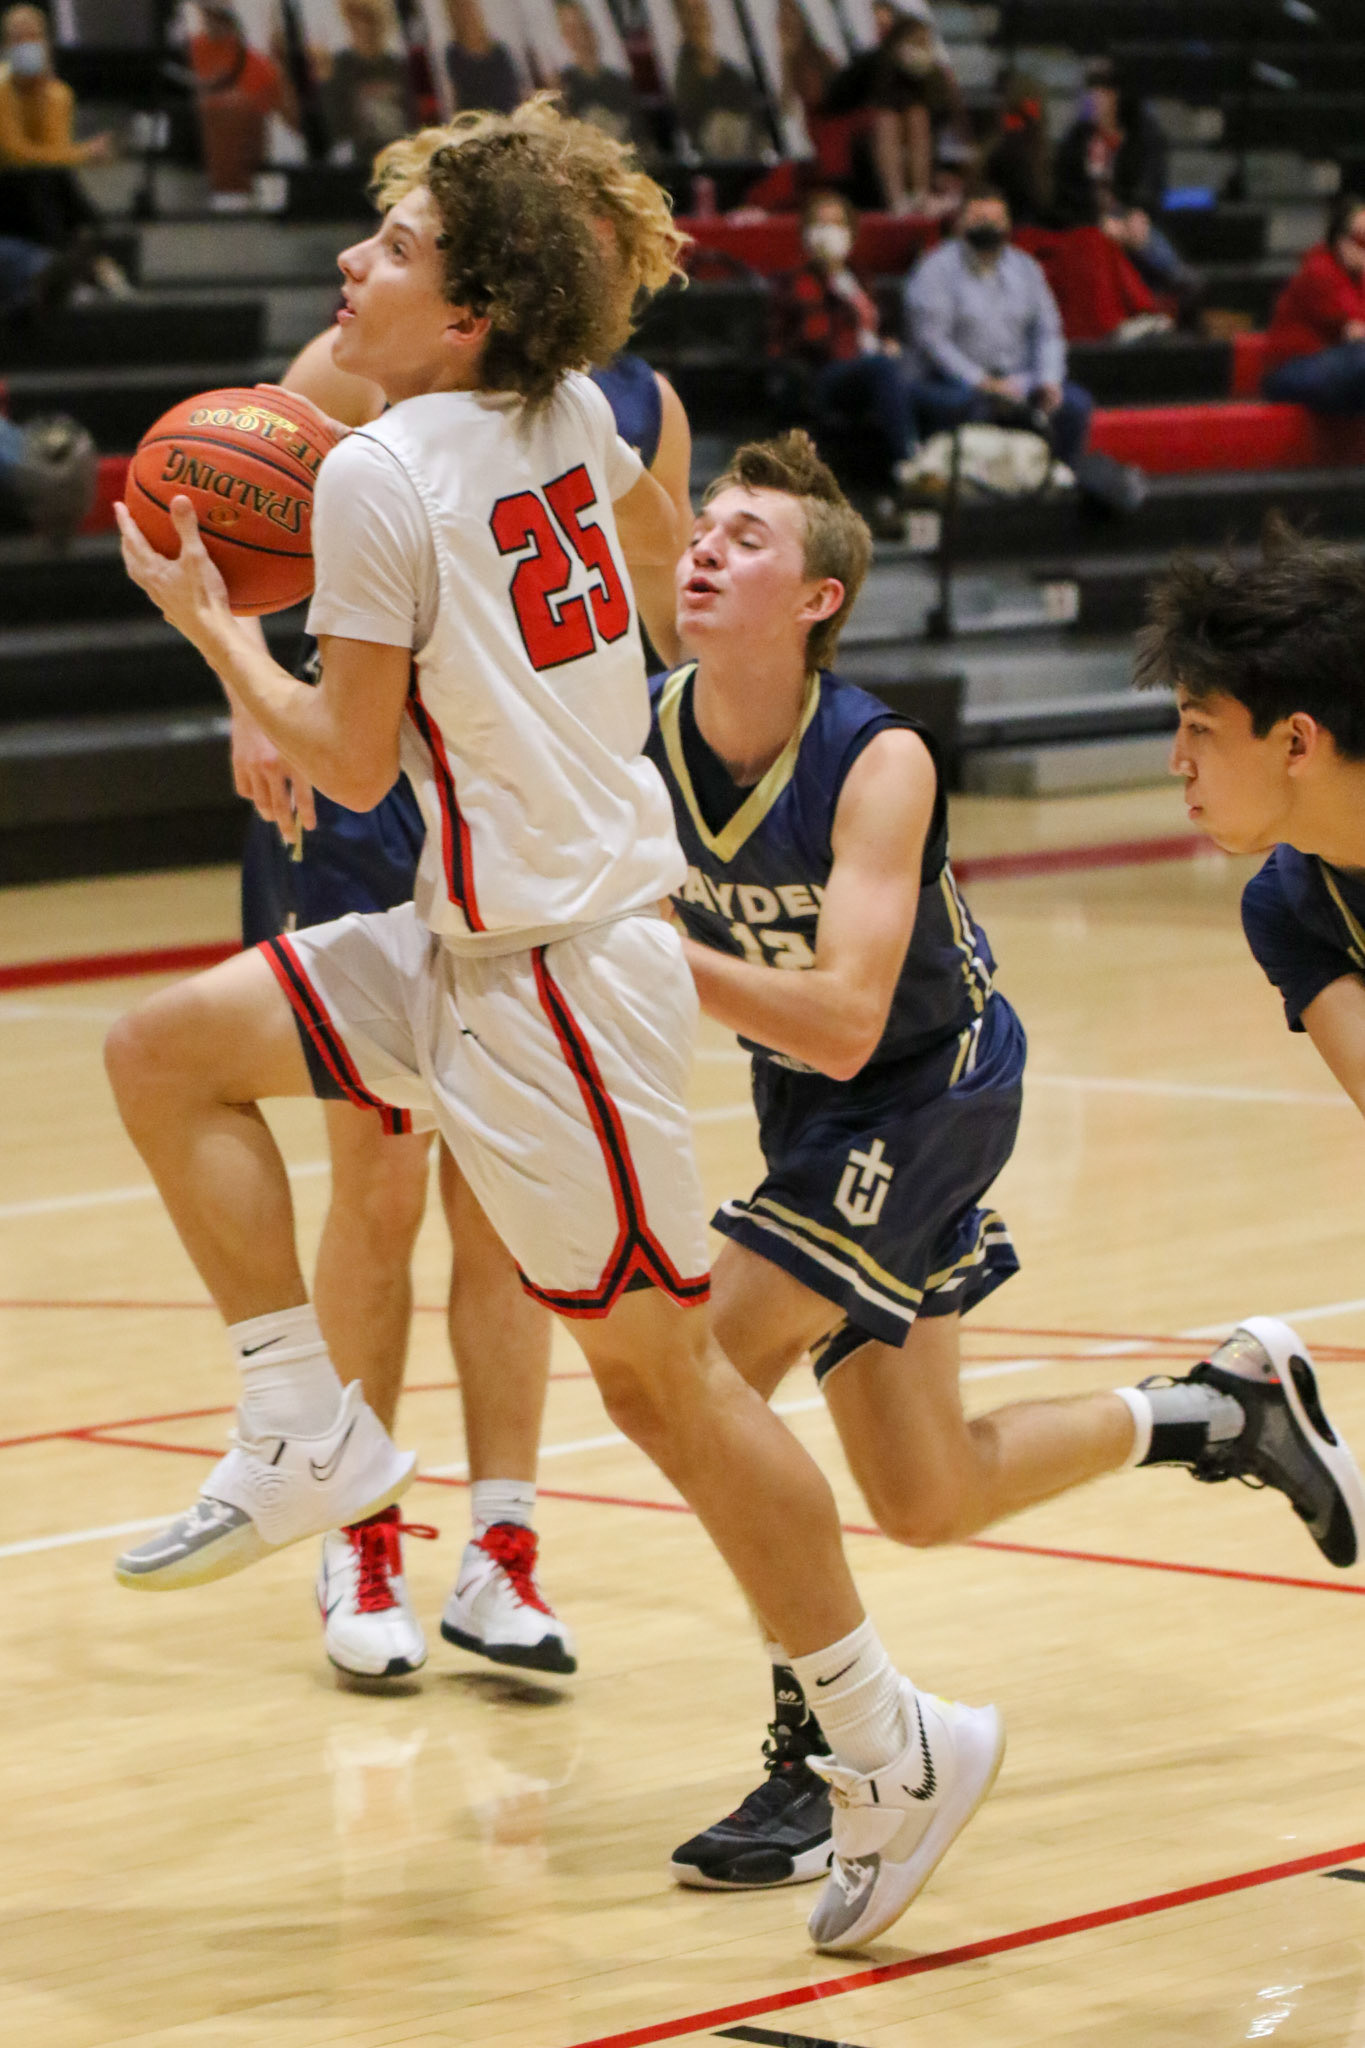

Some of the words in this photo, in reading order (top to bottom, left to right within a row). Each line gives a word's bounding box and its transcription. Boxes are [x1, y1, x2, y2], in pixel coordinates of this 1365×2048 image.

[162, 447, 310, 533] SPALDING
[489, 463, 630, 672] 25
[676, 865, 825, 924] AYDE
